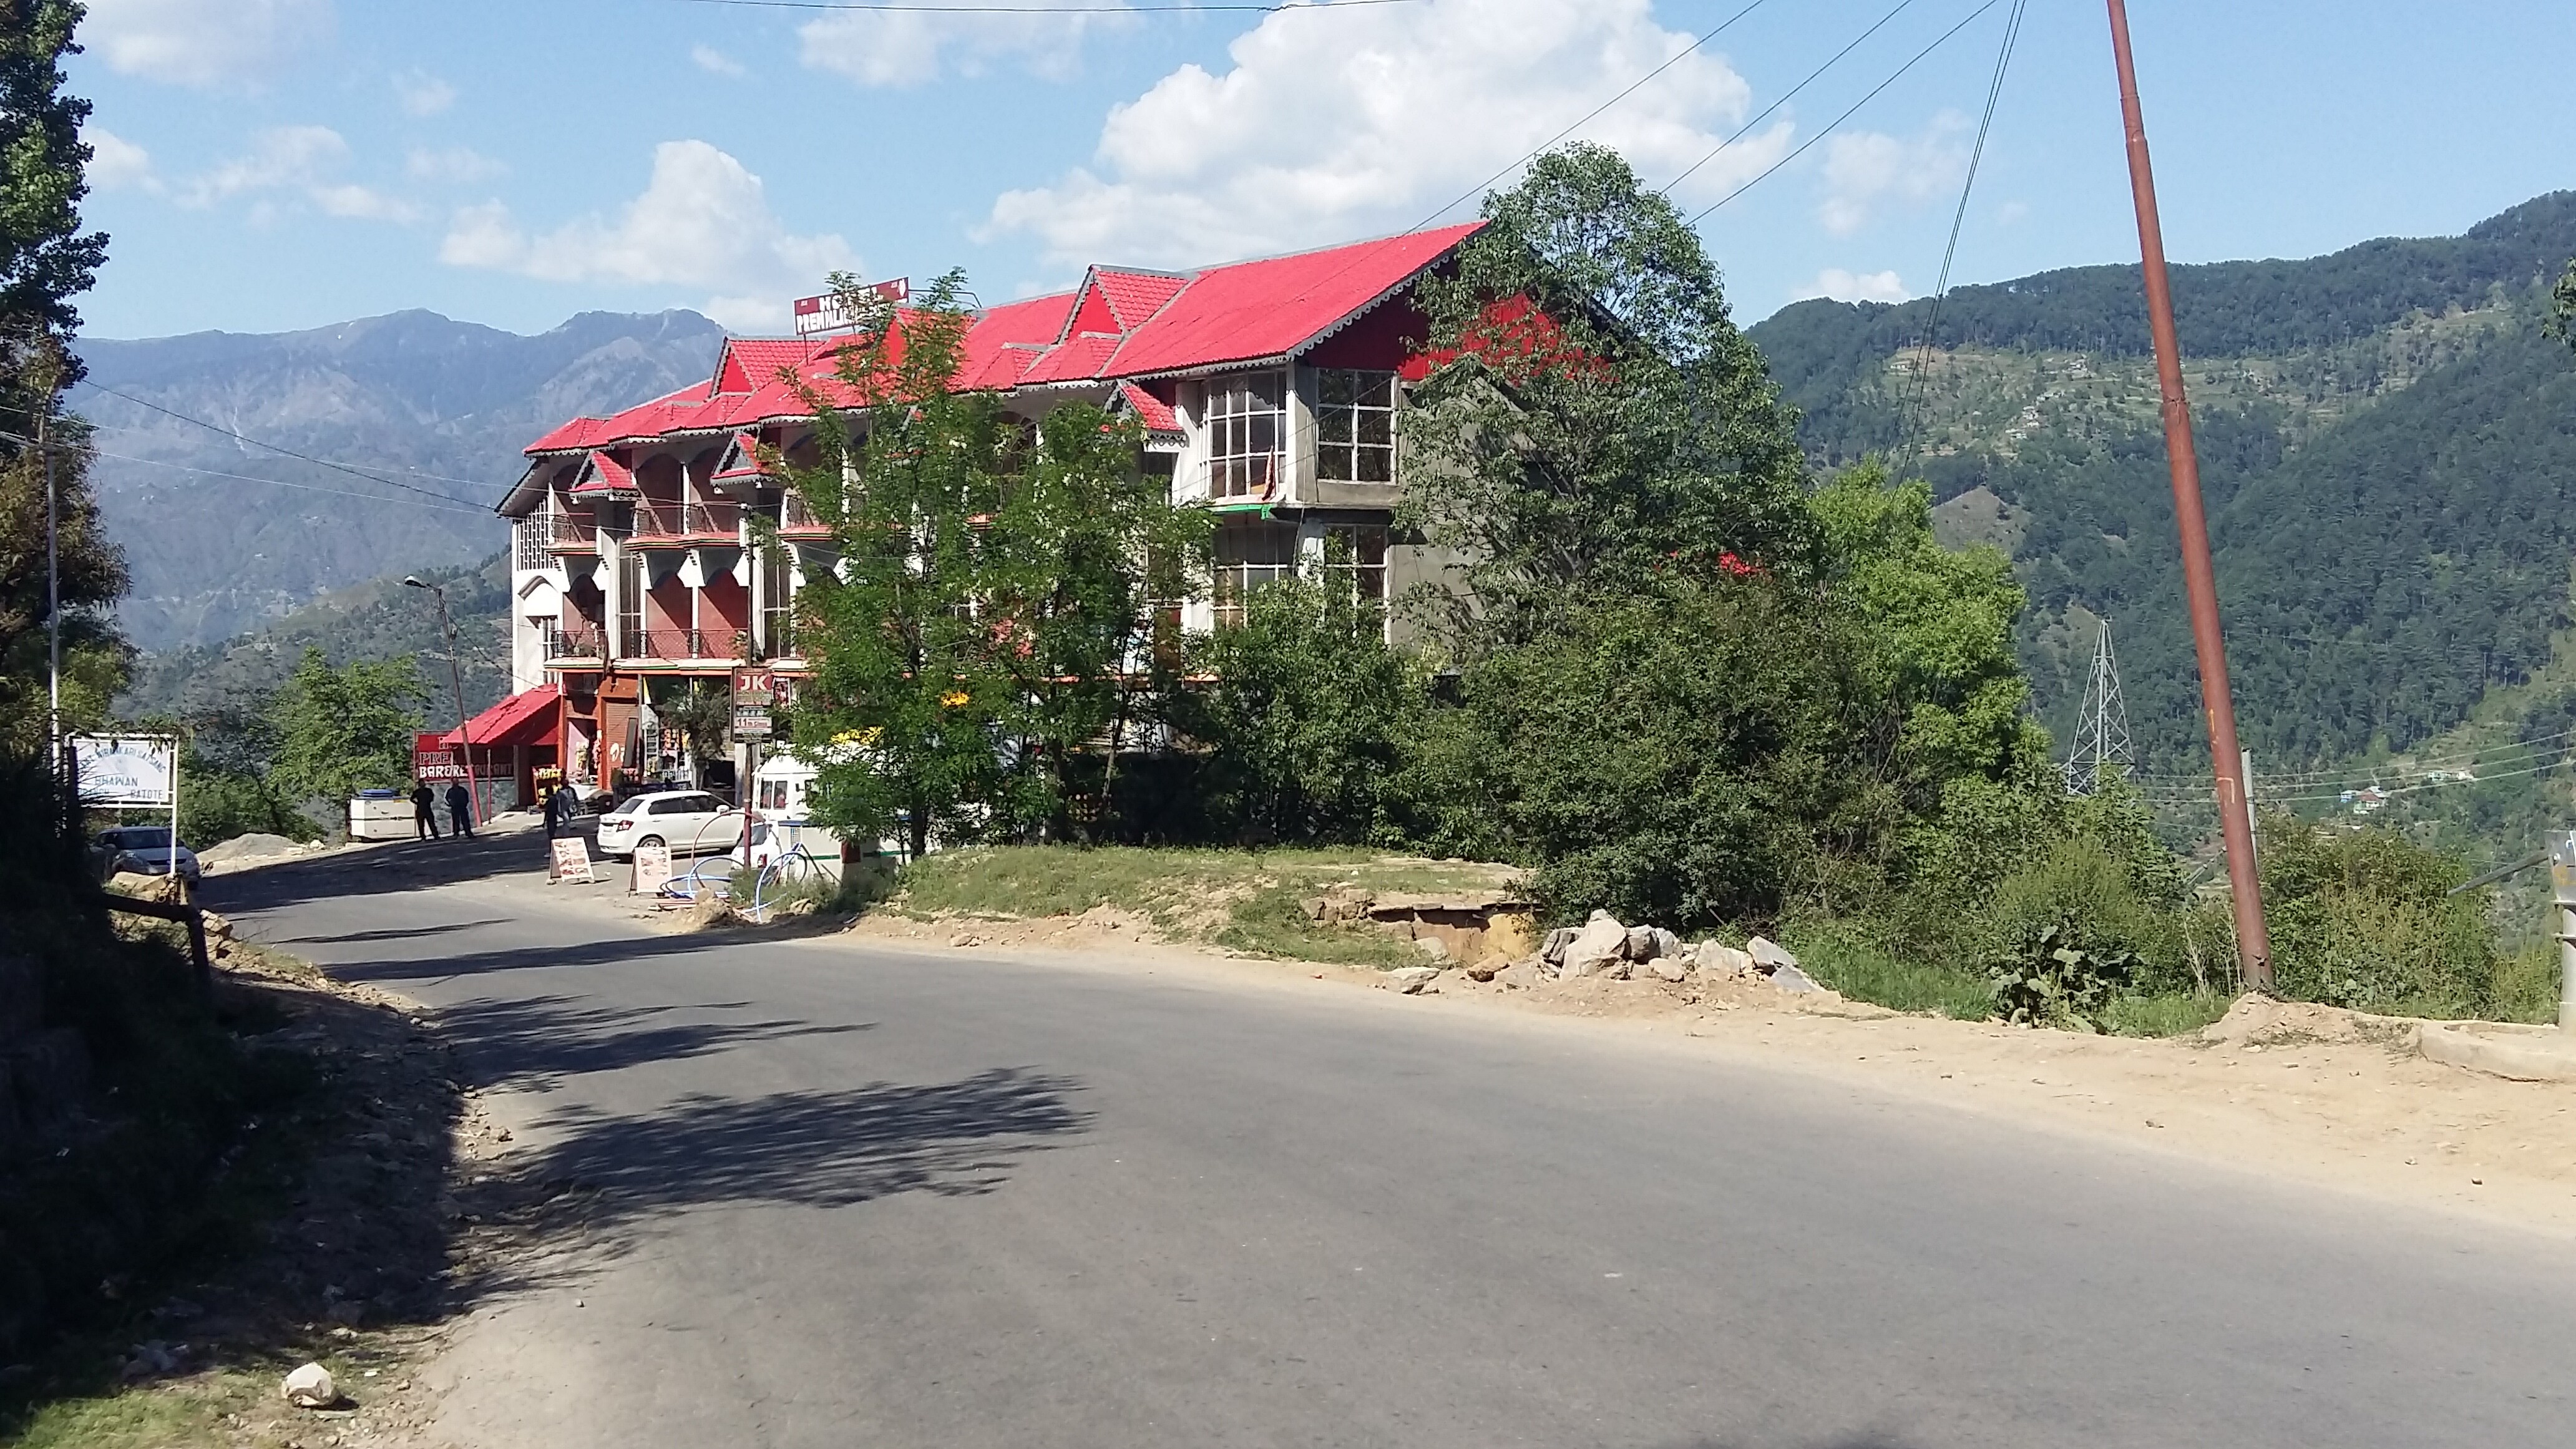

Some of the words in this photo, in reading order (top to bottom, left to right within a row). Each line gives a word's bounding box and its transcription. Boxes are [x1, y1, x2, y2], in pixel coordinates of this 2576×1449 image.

[740, 675, 768, 691] JK
[95, 776, 138, 787] BHAWAN
[130, 789, 163, 799] BATOTE
